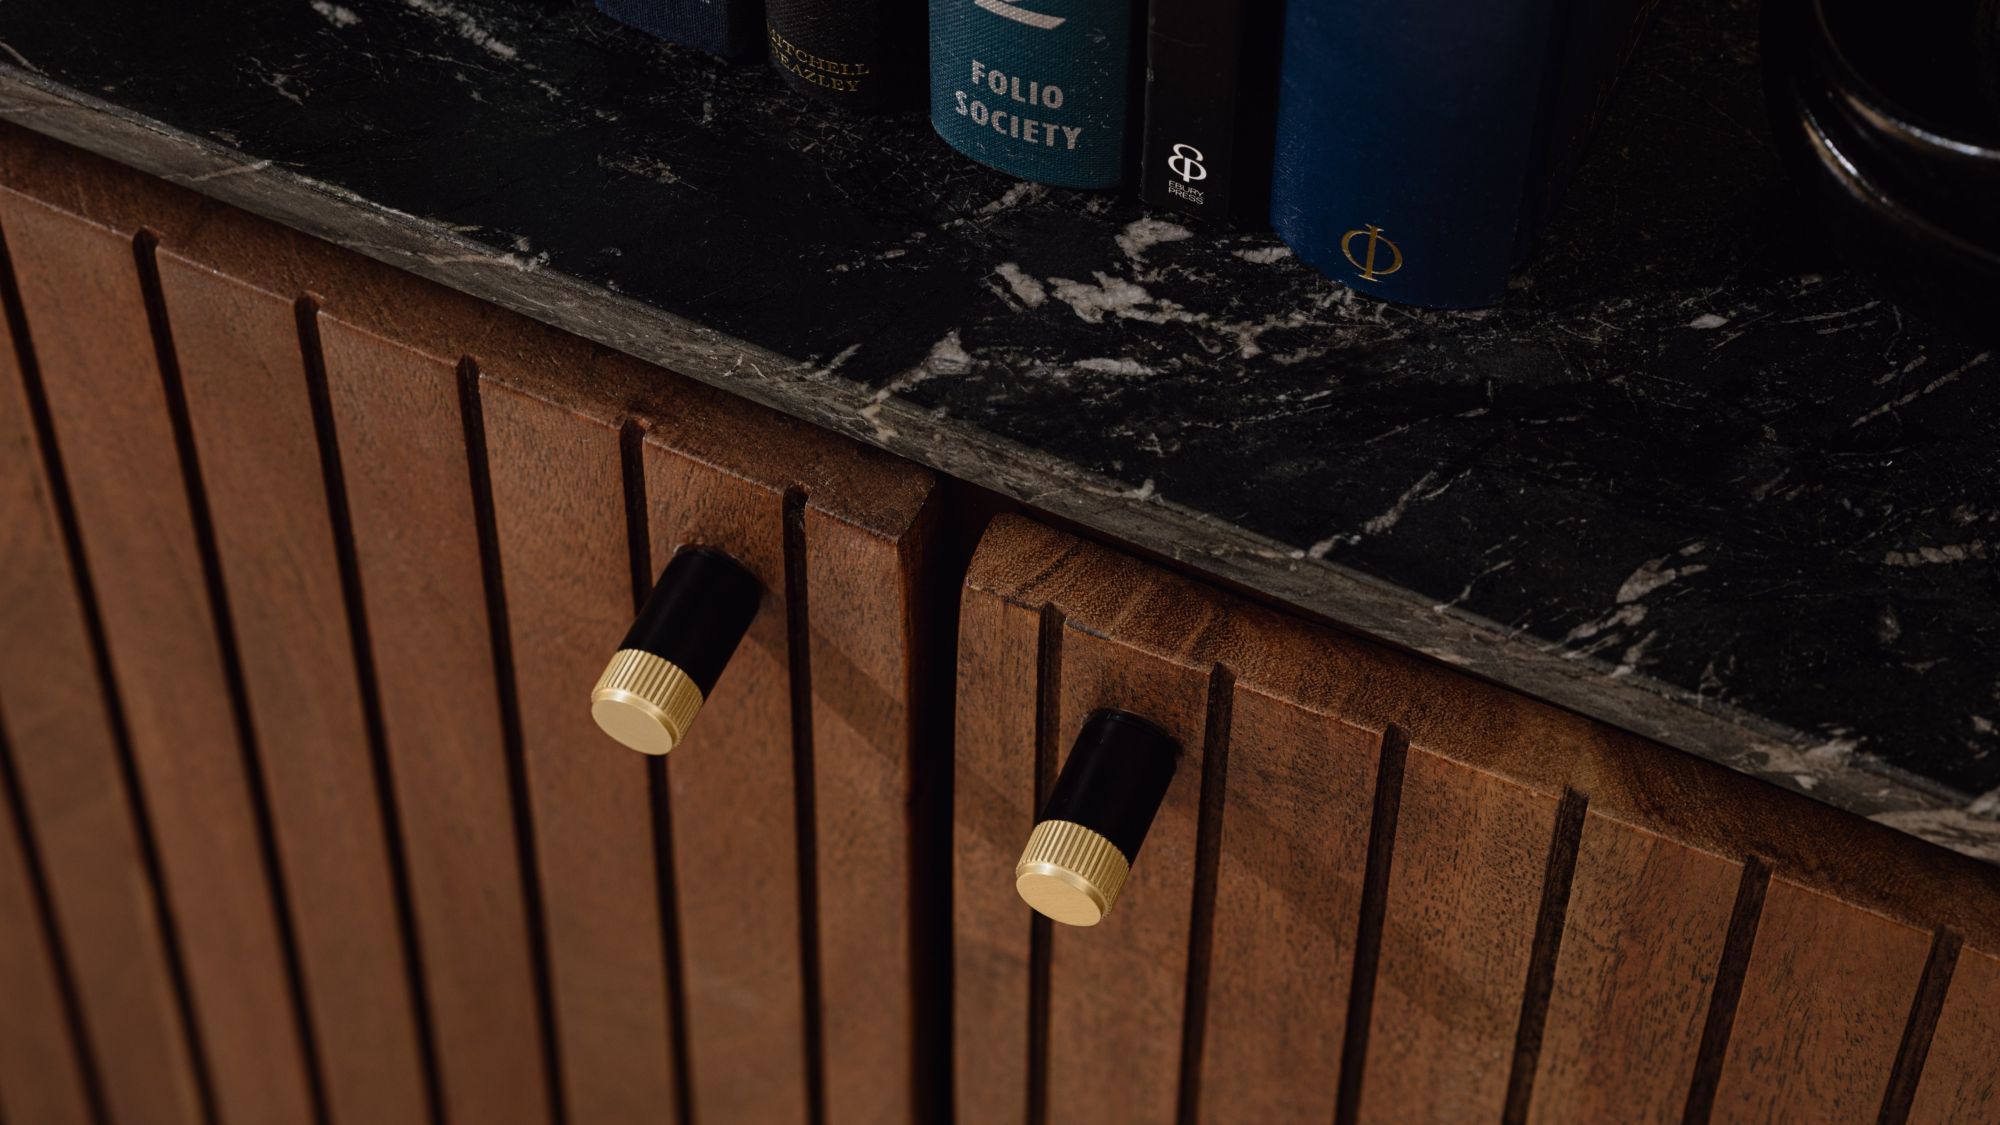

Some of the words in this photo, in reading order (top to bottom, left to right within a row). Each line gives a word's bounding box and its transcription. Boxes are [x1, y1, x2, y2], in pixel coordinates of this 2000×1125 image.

[971, 59, 1064, 110] FOLIO
[955, 90, 1082, 150] SOCIETY
[1168, 180, 1204, 197] EBURY
[1168, 186, 1204, 205] PRESS
